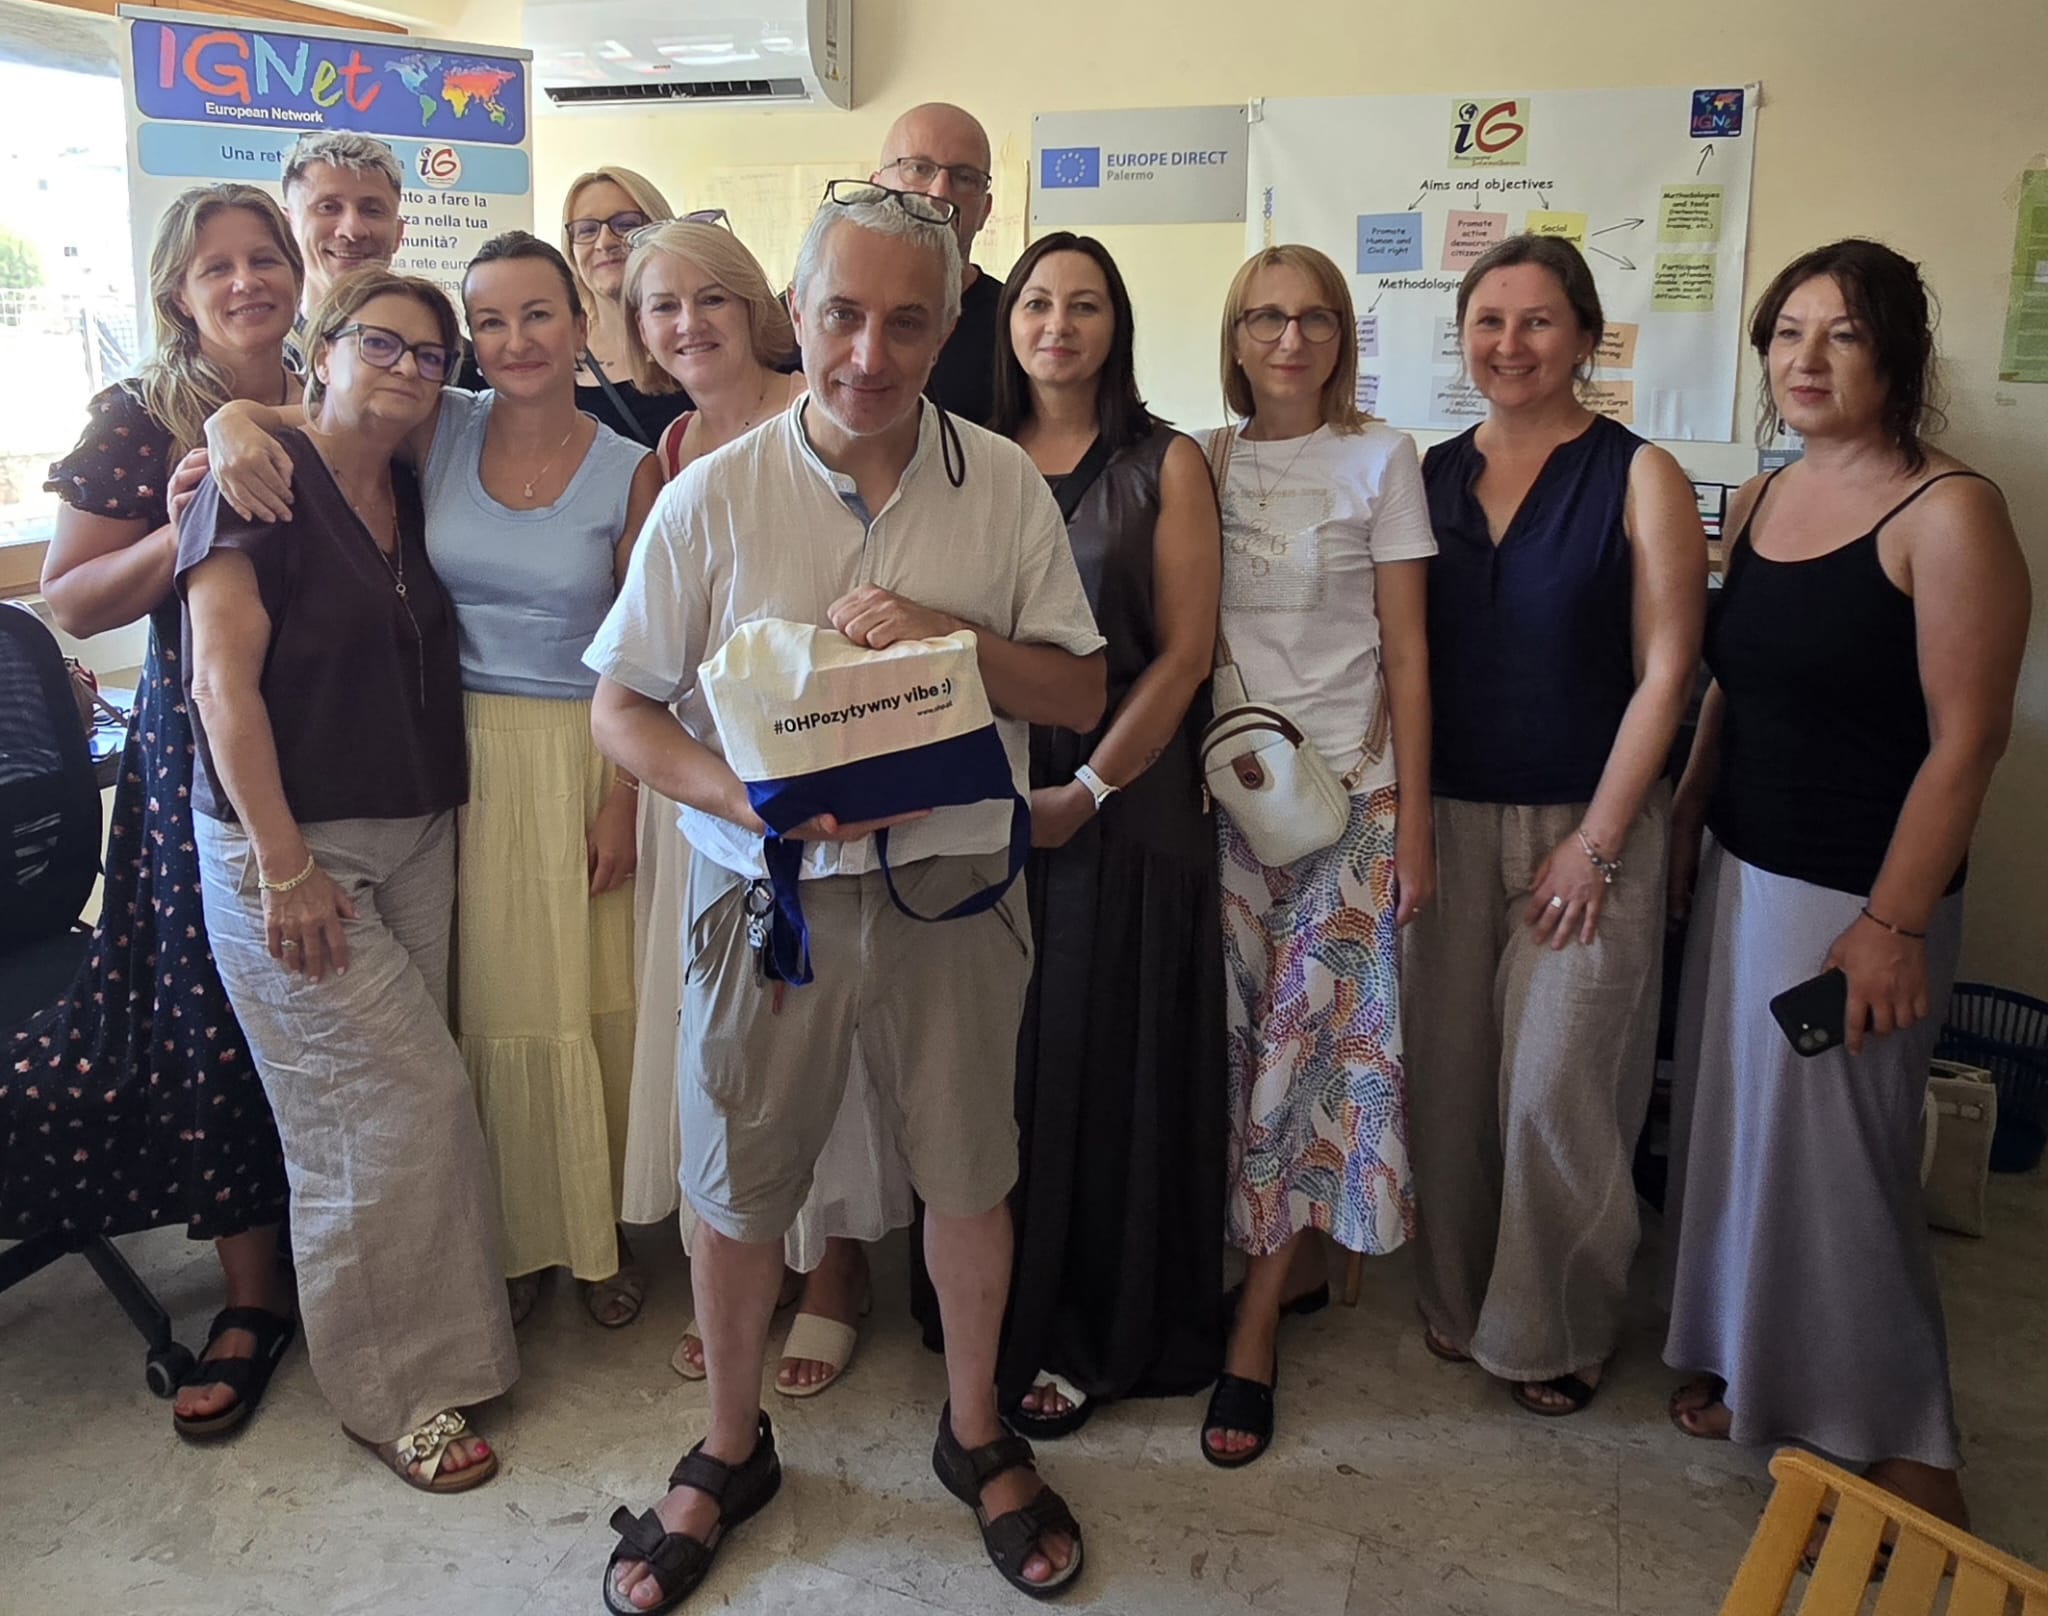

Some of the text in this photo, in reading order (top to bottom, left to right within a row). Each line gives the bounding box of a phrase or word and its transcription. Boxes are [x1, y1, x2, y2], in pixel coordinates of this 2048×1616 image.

[159, 25, 382, 112] IGNet
[205, 102, 324, 123] European Network
[1454, 101, 1524, 154] iG
[221, 146, 285, 162] Una ret
[1107, 150, 1229, 168] EUROPE DIRECT
[1107, 170, 1154, 182] Palermo
[1419, 178, 1554, 192] Aims and objectives
[428, 195, 437, 205] a
[442, 192, 470, 206] fare
[474, 195, 487, 207] la
[425, 214, 461, 228] nella
[466, 217, 488, 229] tua
[1458, 219, 1493, 228] Promote
[1371, 226, 1406, 236] Promote
[1461, 230, 1488, 238] active
[1366, 236, 1412, 245] Human and
[1388, 247, 1409, 256] right
[411, 258, 437, 270] rete
[1378, 278, 1463, 292] Methodologie
[903, 685, 939, 703] vibe
